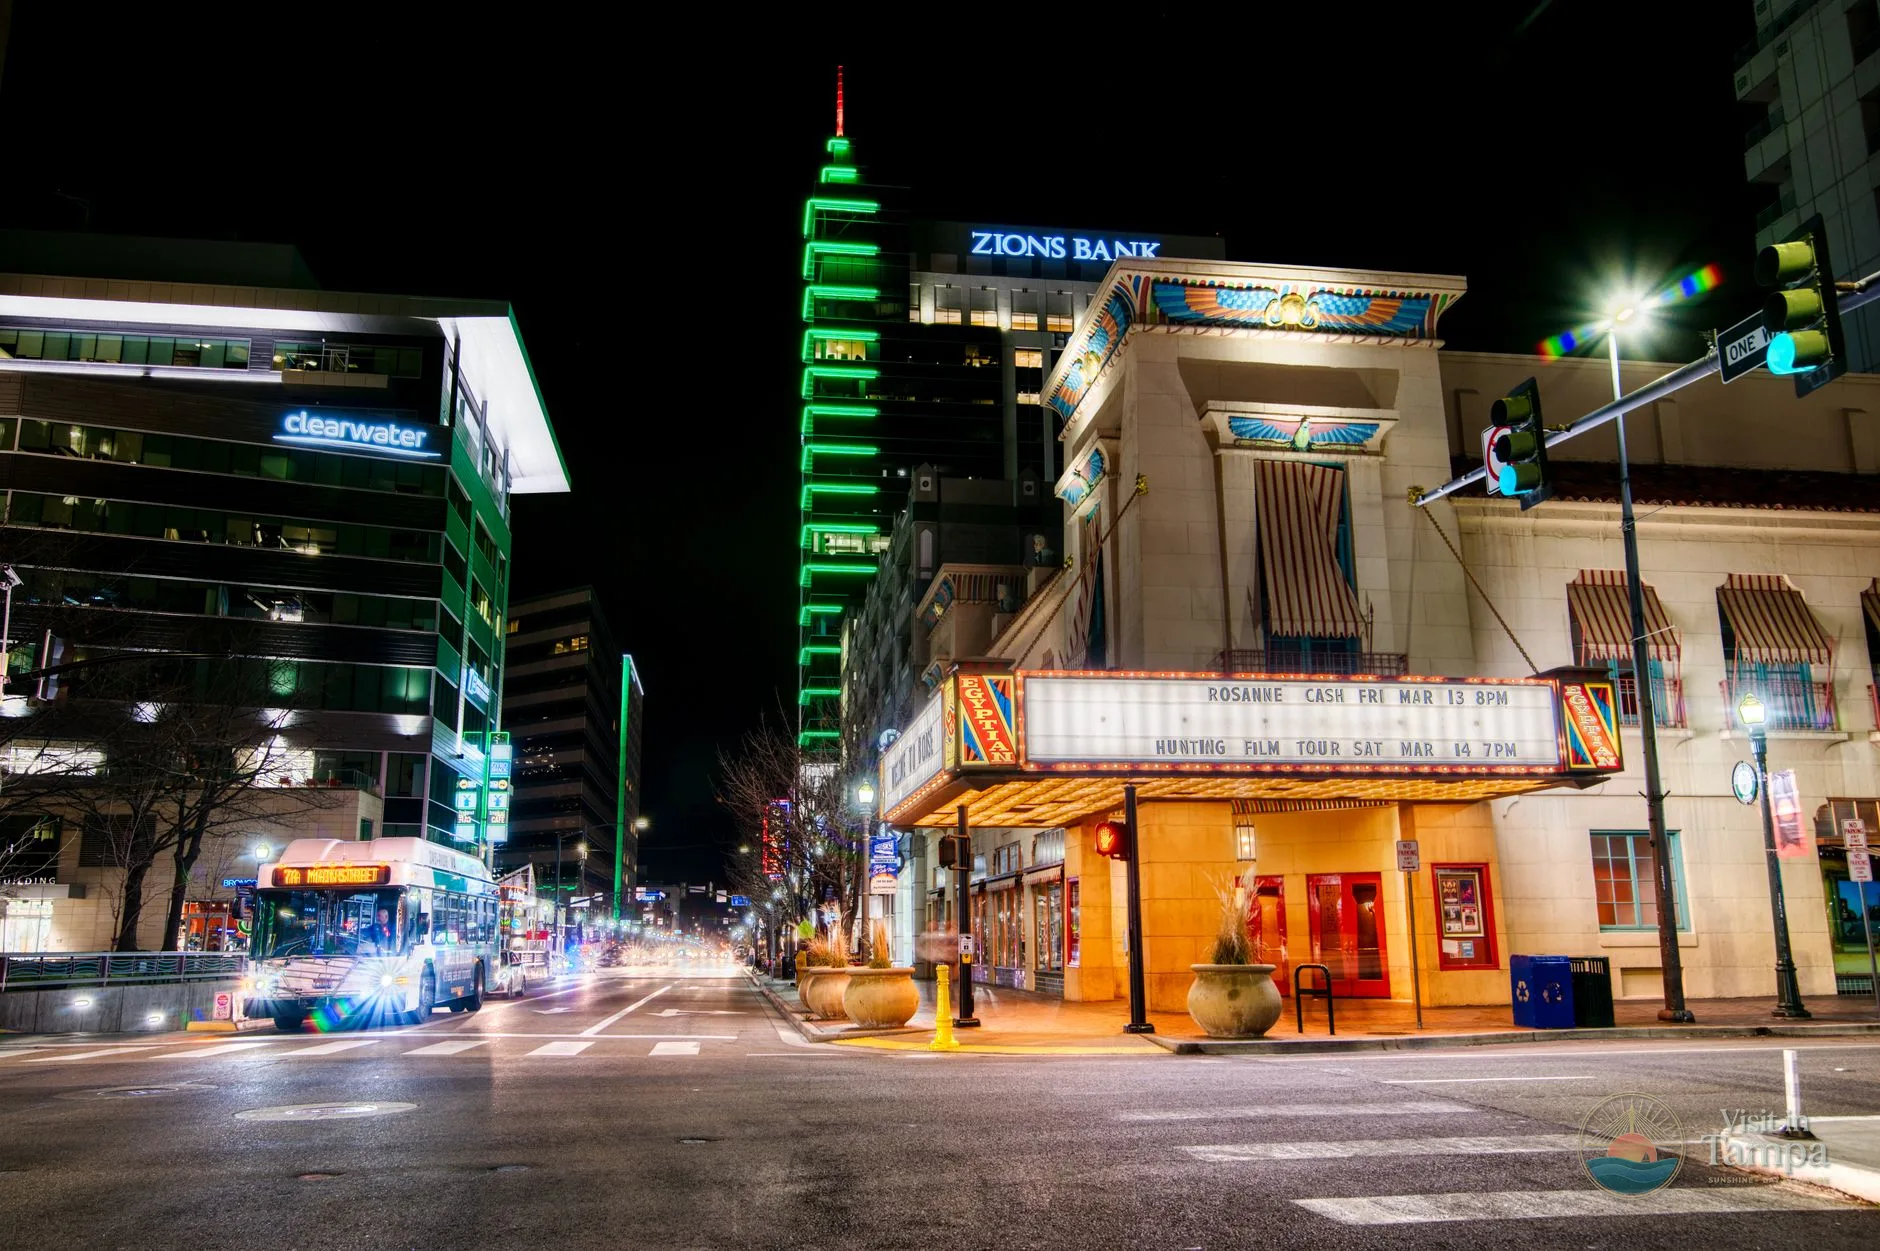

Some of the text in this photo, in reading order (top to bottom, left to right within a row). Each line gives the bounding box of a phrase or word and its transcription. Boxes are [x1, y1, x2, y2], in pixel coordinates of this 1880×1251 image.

[972, 232, 1160, 261] ZIONS BANK
[1730, 335, 1756, 361] ONE
[284, 410, 427, 448] clearwater
[1208, 686, 1508, 705] ROSANNE CASH FRI MAR 13 8PM
[961, 678, 1016, 762] EGYPTIAN
[1564, 685, 1617, 767] EGYPTIAN
[1156, 739, 1517, 757] HUNTING FILM TOUR SAT MAR 14 7PM
[0, 877, 56, 885] UILDING
